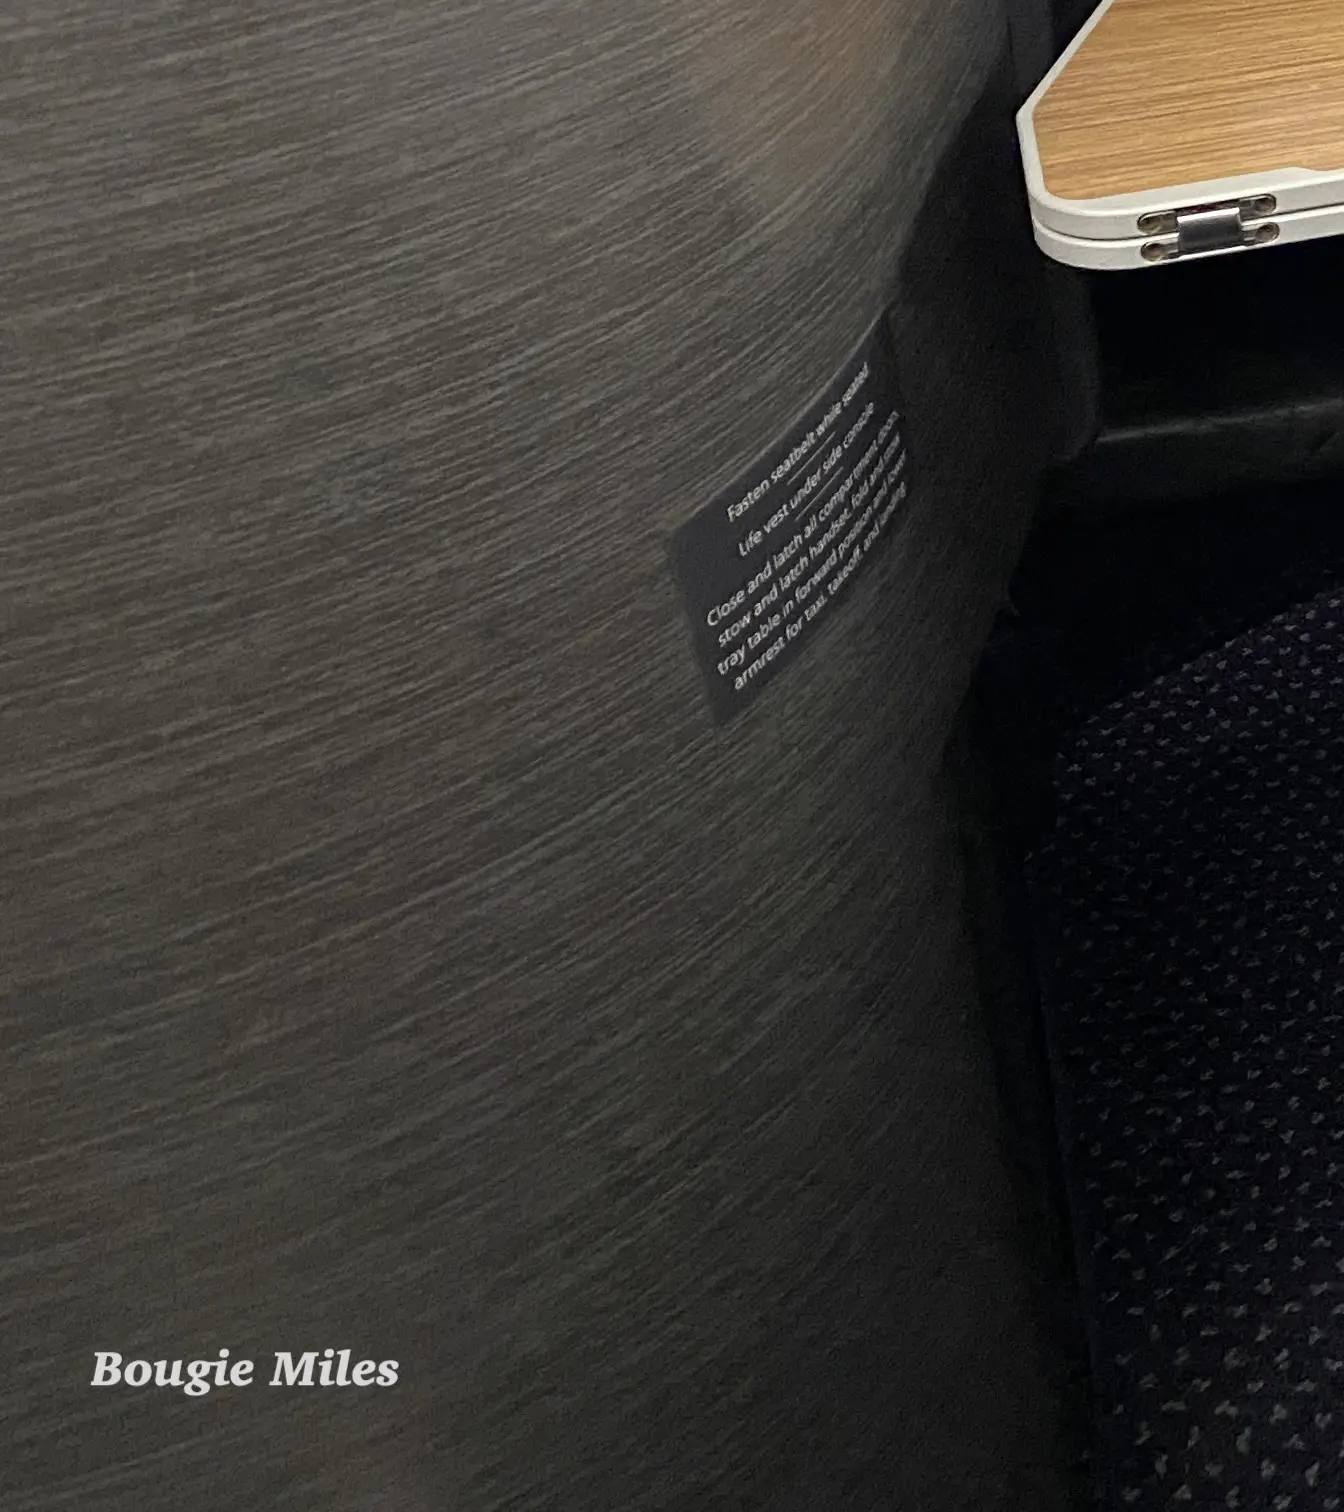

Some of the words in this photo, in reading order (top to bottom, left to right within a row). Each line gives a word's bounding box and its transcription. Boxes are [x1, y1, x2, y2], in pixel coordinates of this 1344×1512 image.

[726, 478, 770, 524] Fasten
[770, 431, 817, 484] seatbelt
[816, 401, 842, 436] while
[842, 361, 869, 407] seated
[738, 529, 763, 557] Life
[763, 503, 789, 534] vest
[789, 467, 822, 508] under
[822, 444, 843, 474] side
[843, 402, 874, 449] console
[706, 588, 746, 627] Close
[747, 560, 773, 594] and
[773, 534, 803, 569] latch
[803, 514, 818, 539] all
[818, 439, 878, 522] compartment
[717, 644, 746, 676] tray
[746, 612, 781, 650] table
[781, 599, 794, 618] in
[795, 548, 837, 604] forward
[838, 505, 872, 560] position
[872, 480, 888, 509] and
[718, 611, 752, 648] stow
[753, 582, 778, 618] and
[778, 555, 809, 592] latch
[851, 479, 868, 509] fold
[734, 635, 785, 691] armrest
[785, 616, 803, 642] for
[863, 523, 880, 551] and
